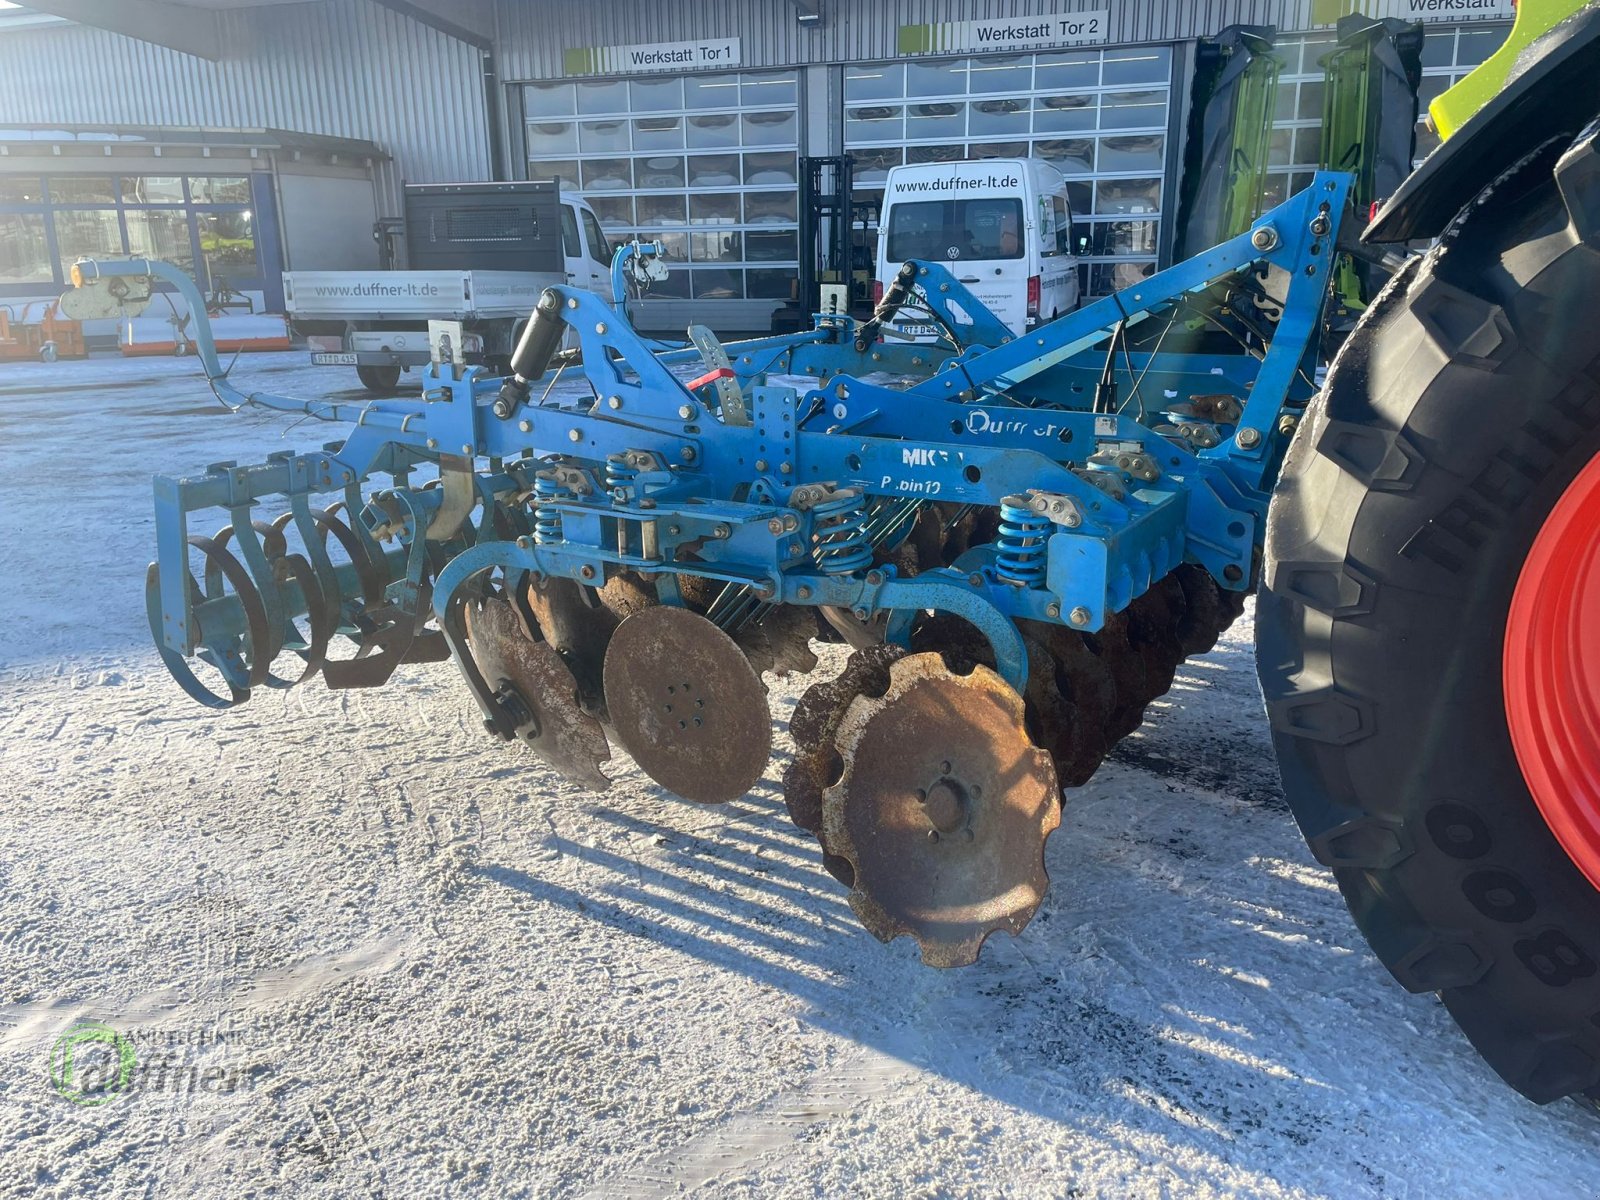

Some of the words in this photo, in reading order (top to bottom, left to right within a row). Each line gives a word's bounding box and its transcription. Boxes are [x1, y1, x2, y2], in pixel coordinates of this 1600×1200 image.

[977, 23, 1050, 42] Werkstatt
[1059, 20, 1085, 36] Tor
[1088, 19, 1099, 33] 2
[631, 48, 693, 65] Werkstatt
[700, 46, 721, 61] Tor
[724, 45, 731, 58] 1
[895, 174, 1018, 193] www.duffner-lt.de
[314, 282, 439, 297] www.duffner-lt.de
